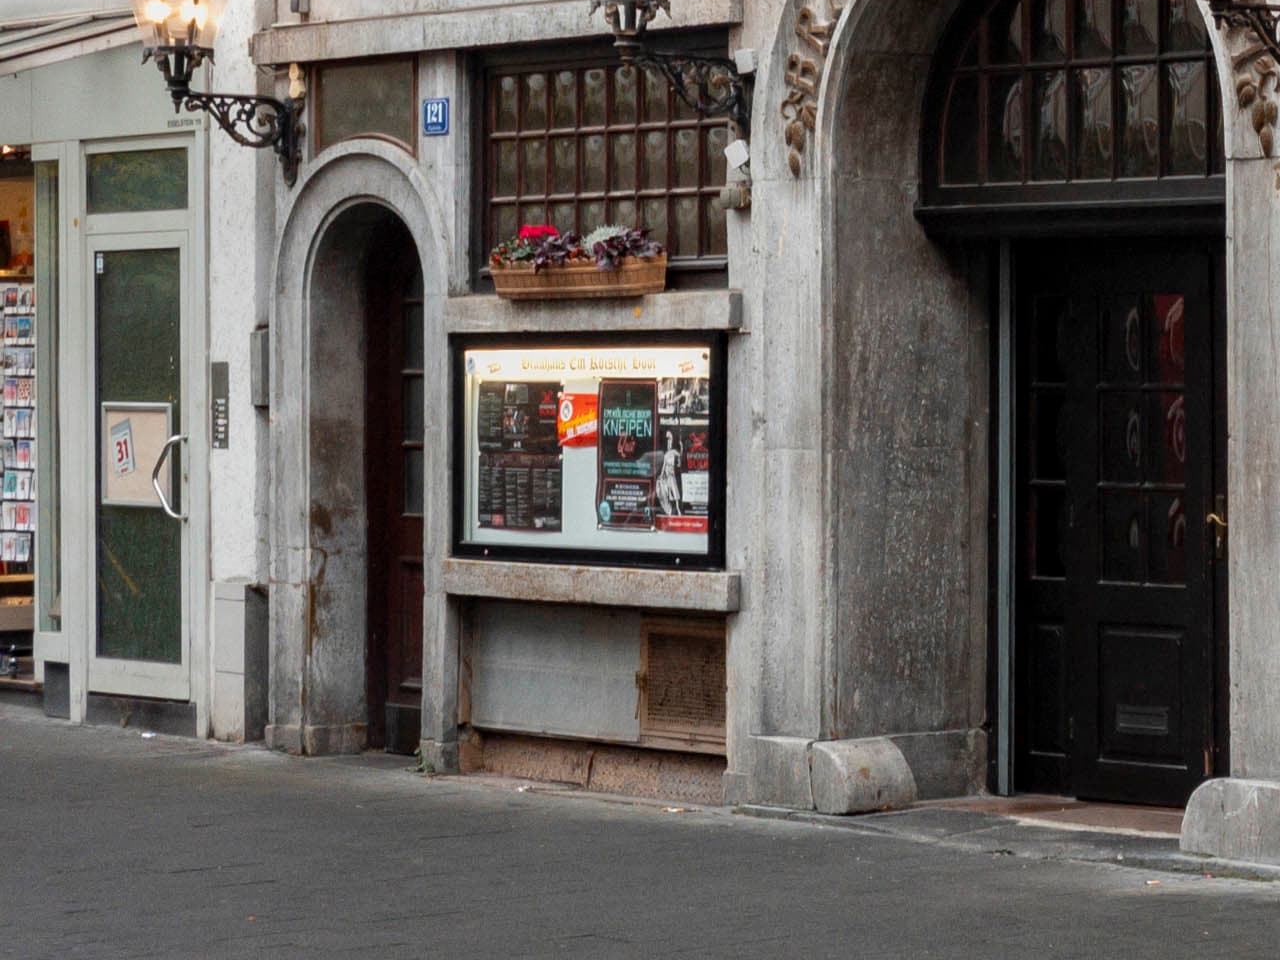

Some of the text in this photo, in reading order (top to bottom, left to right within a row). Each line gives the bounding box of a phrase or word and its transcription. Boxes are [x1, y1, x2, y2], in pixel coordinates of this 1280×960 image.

[427, 103, 443, 123] 121
[603, 418, 652, 437] KNEIPEN
[116, 438, 129, 463] 31
